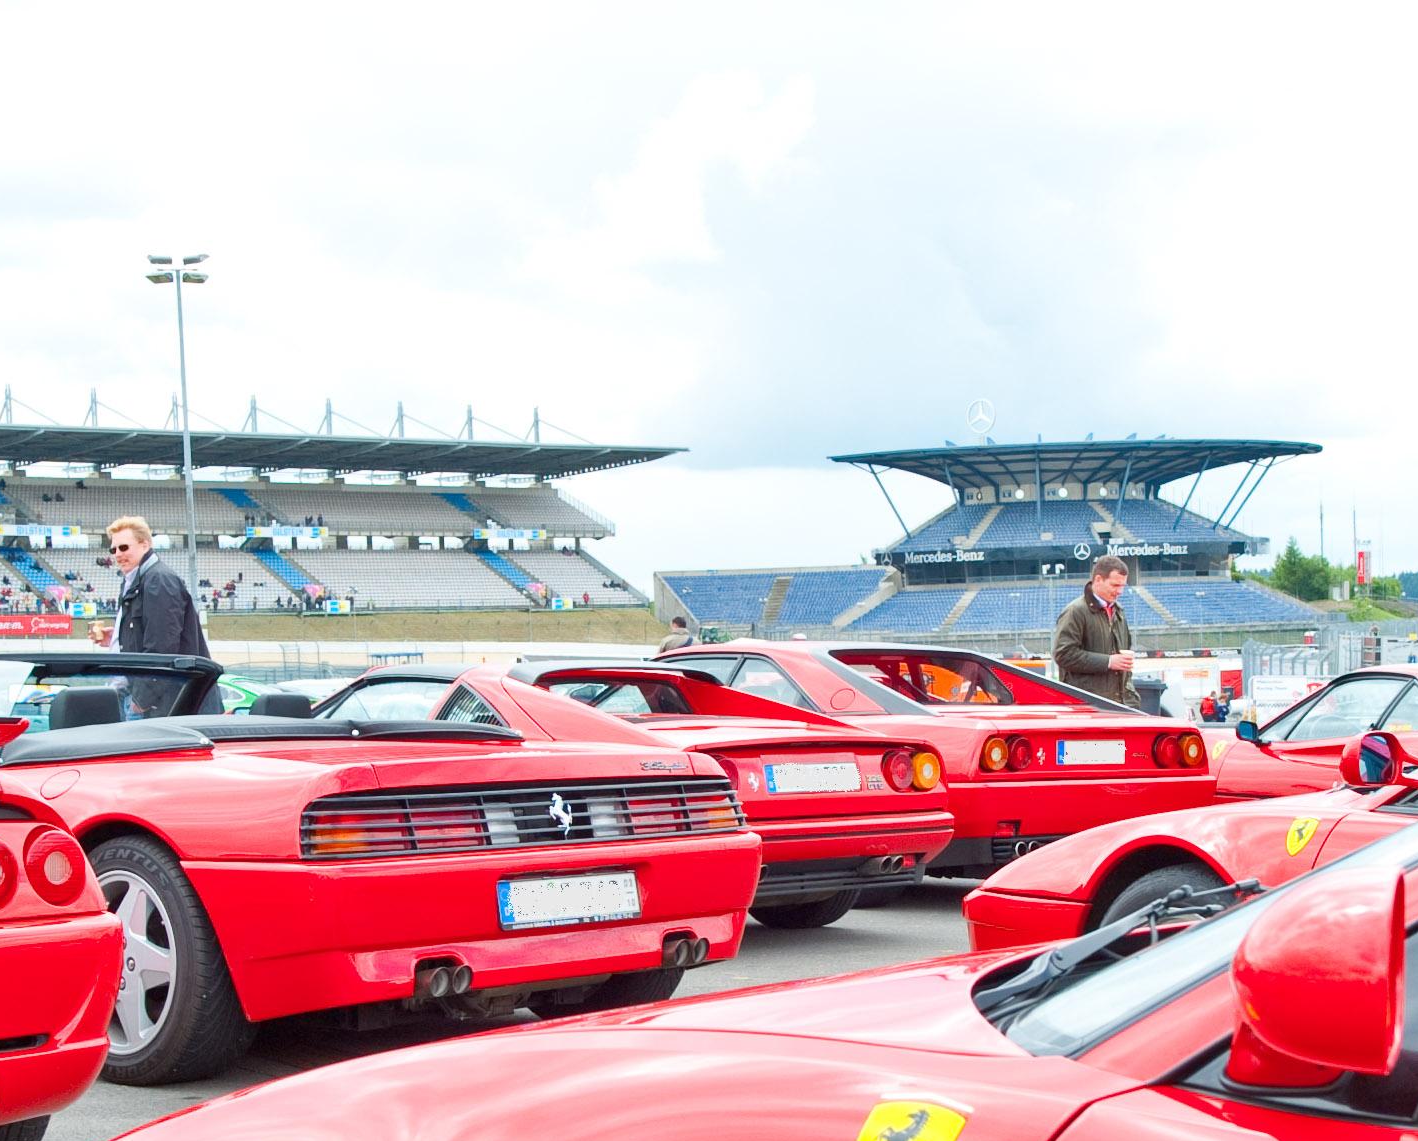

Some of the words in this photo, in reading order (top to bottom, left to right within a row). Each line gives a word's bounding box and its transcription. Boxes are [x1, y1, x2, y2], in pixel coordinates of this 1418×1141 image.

[904, 550, 985, 564] Mercedes-Benz
[1107, 543, 1188, 557] Mercedes-Benz
[91, 848, 170, 887] VENTUS
